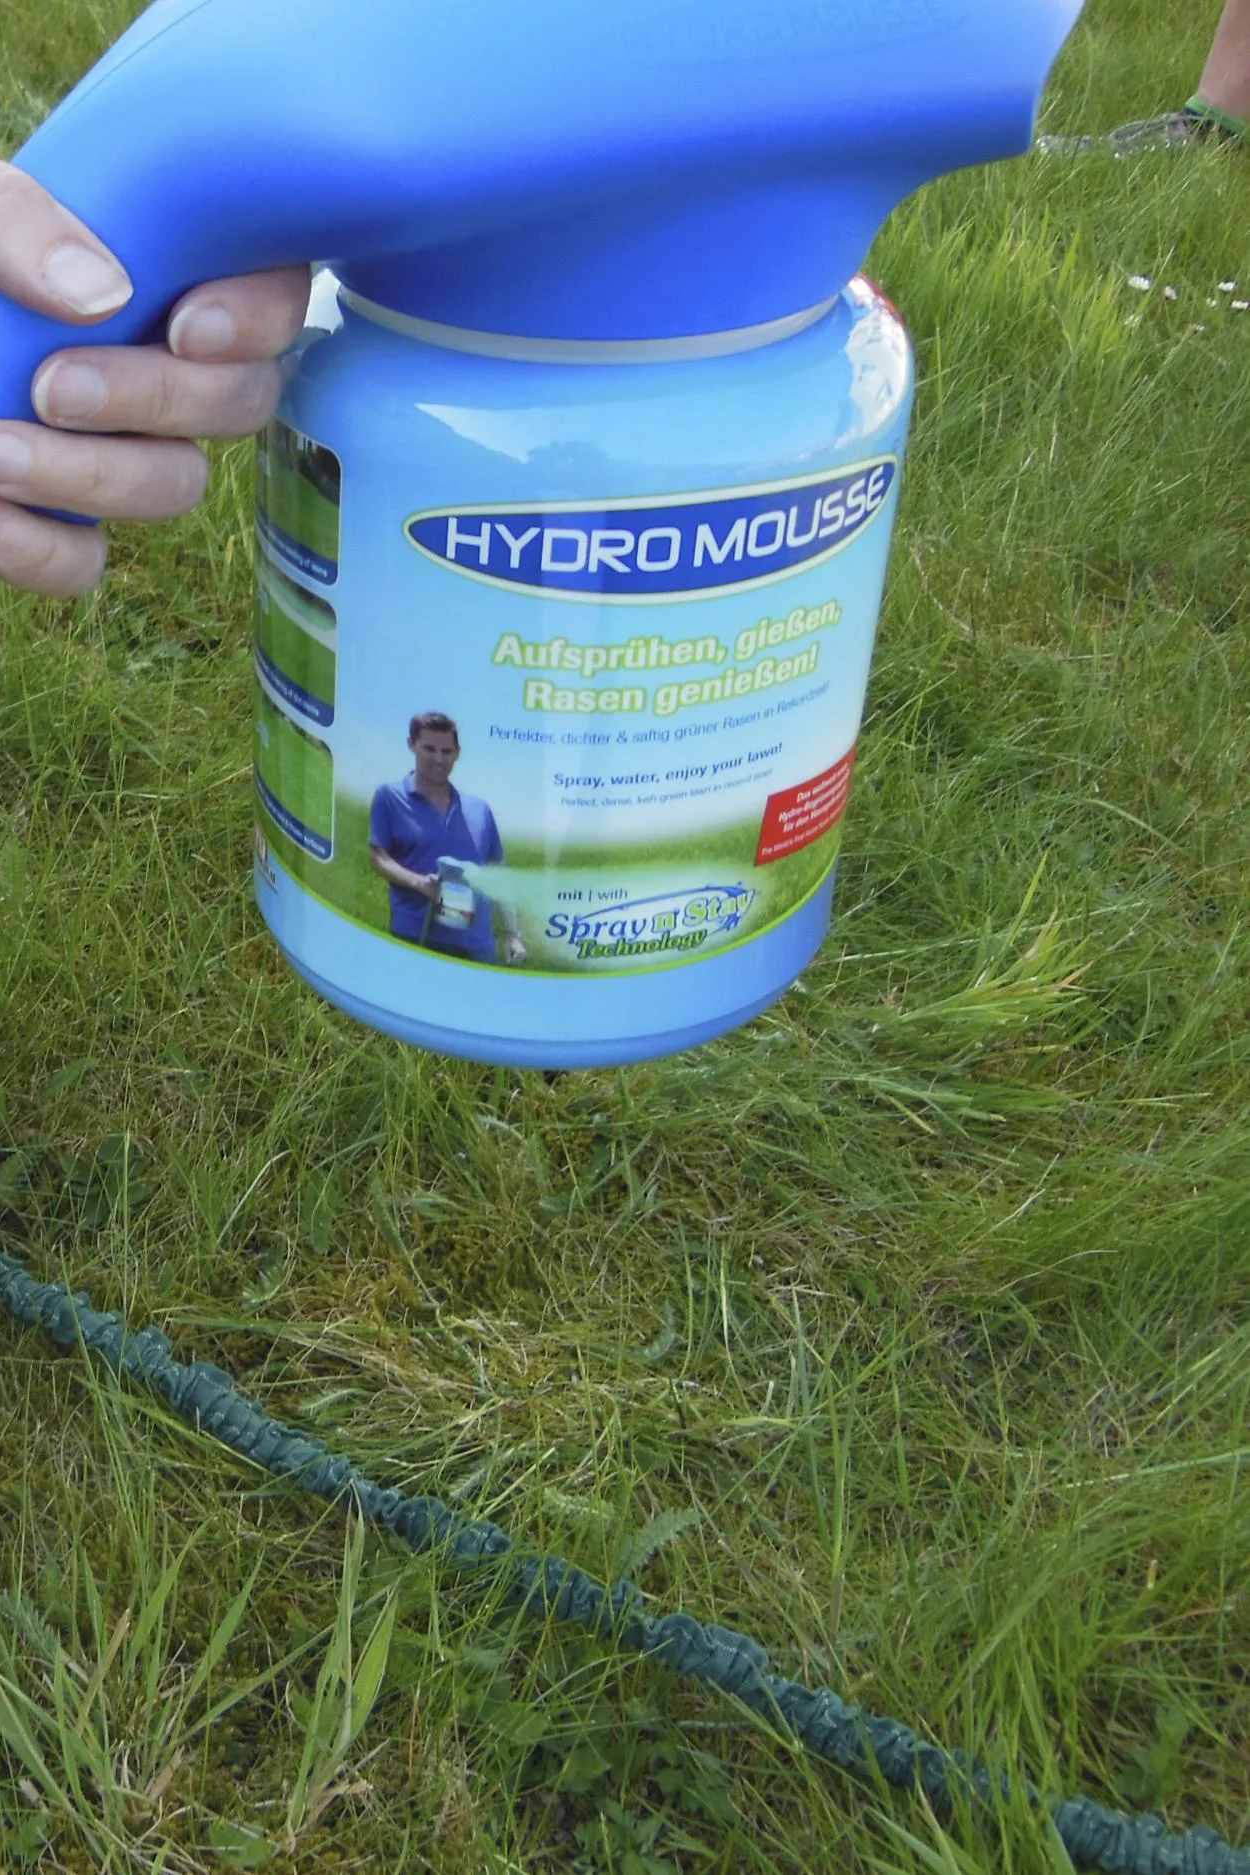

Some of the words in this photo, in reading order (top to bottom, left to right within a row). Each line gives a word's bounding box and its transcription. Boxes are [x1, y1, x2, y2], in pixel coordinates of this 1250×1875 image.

[446, 516, 682, 574] HYDRO
[693, 465, 885, 568] MOUSSE
[493, 633, 727, 677] Aufsprühen,
[735, 599, 841, 661] gießen,
[524, 678, 646, 713] Rasen
[654, 642, 819, 715] genießen!
[489, 724, 557, 745] Perfekter,
[561, 731, 611, 745] dichter
[616, 730, 628, 744] &
[632, 728, 670, 743] saftig
[674, 720, 719, 740] grüner
[723, 711, 761, 729] Rasen
[763, 706, 774, 719] in
[553, 773, 605, 788] Spray,
[610, 773, 660, 785] water,
[665, 765, 708, 780] enjoy
[711, 756, 744, 775] your
[747, 742, 783, 763] lawn!
[545, 912, 648, 944] Spray
[682, 888, 756, 927] Stay
[557, 887, 583, 900] mit
[597, 887, 628, 900] with
[576, 929, 708, 959] Technology
